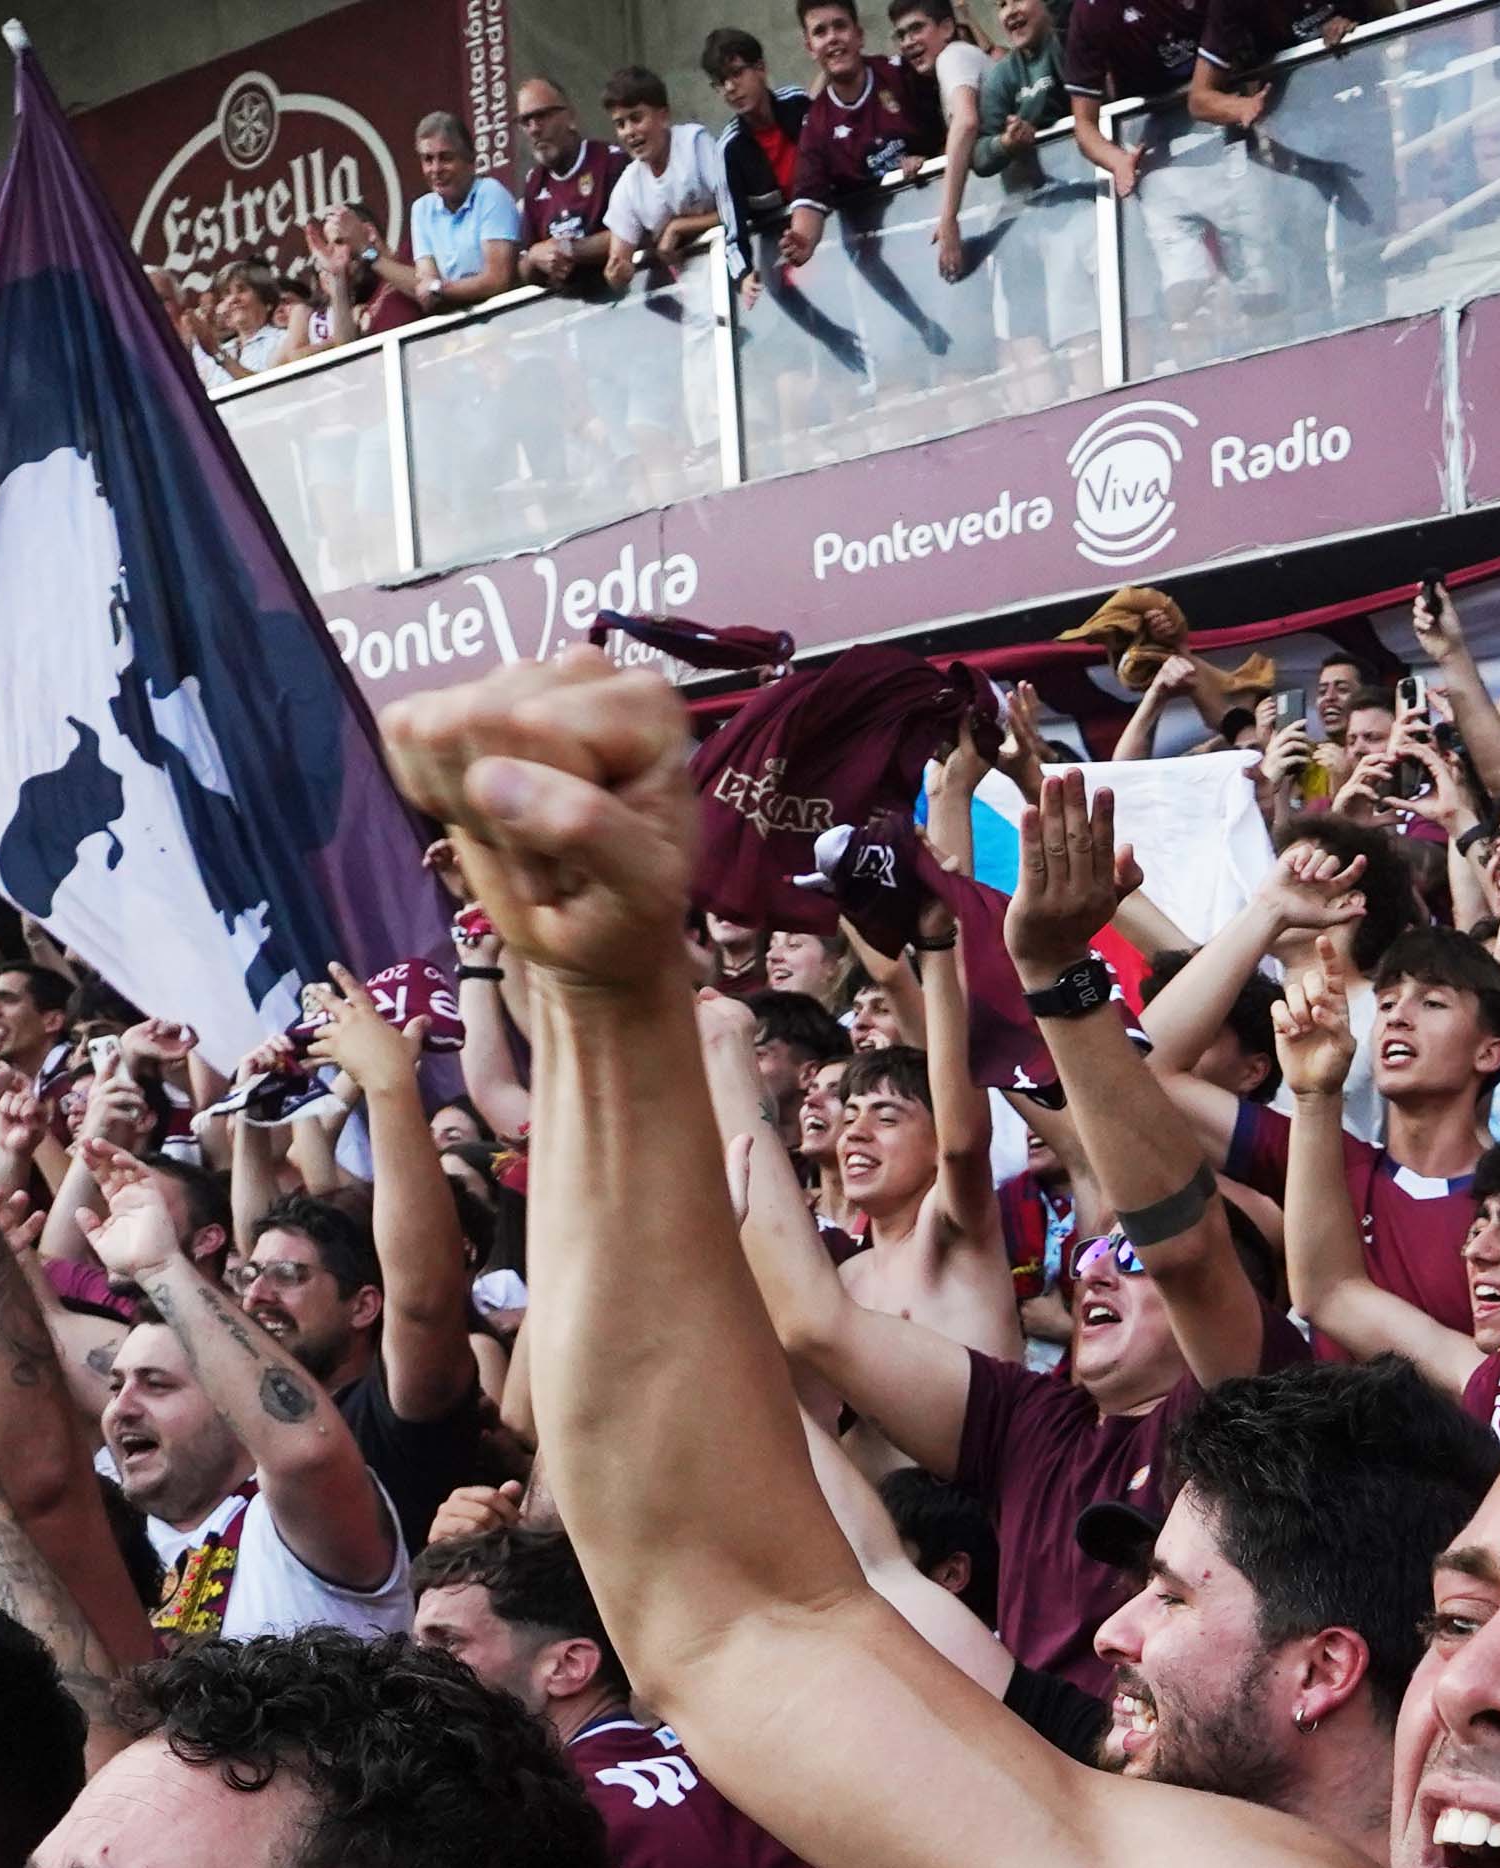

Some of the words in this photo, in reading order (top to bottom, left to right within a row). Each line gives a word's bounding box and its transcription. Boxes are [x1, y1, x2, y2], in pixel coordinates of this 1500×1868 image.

[163, 148, 364, 272] Estrella
[812, 491, 1054, 580] Pontevedra
[1082, 470, 1168, 516] Viva
[1209, 416, 1352, 489] Radio
